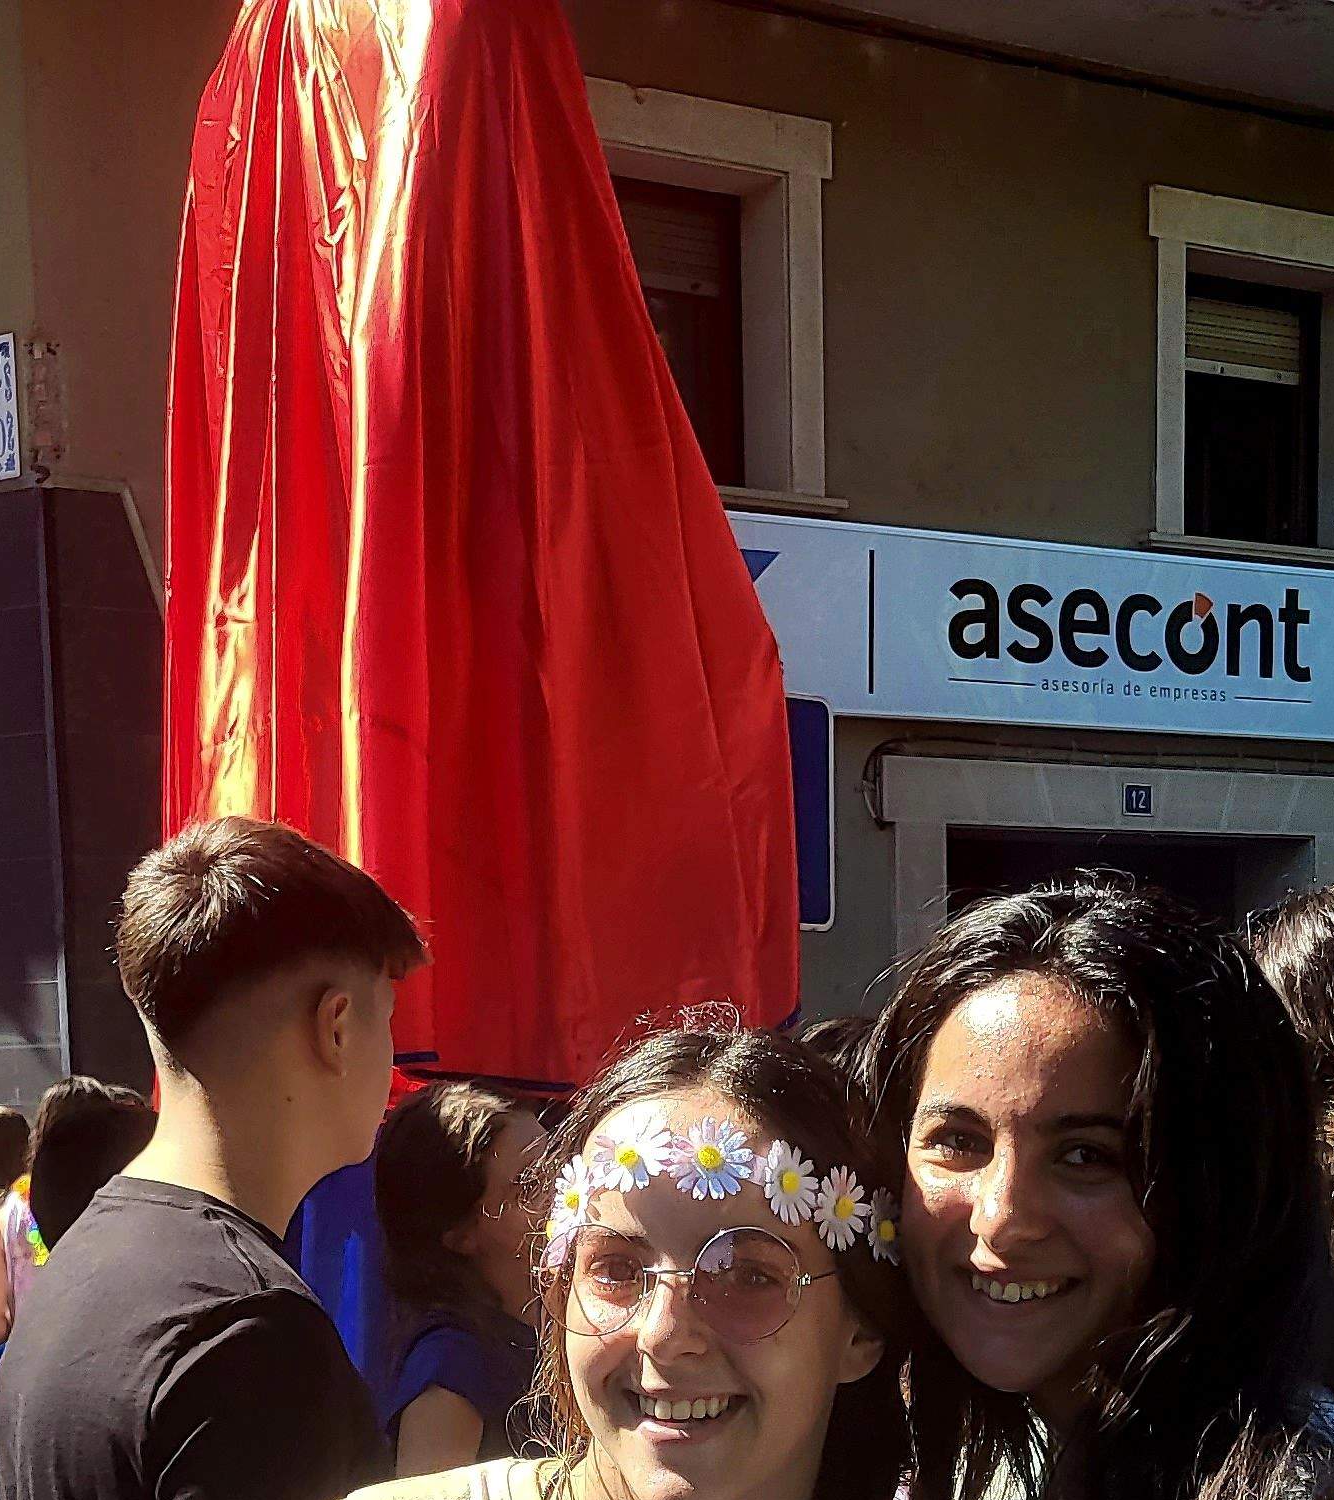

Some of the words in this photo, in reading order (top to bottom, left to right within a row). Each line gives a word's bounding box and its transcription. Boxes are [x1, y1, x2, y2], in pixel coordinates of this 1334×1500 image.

[948, 578, 1312, 683] asecont
[1123, 679, 1143, 698] de
[1149, 683, 1228, 703] empresas
[1131, 790, 1146, 810] 12
